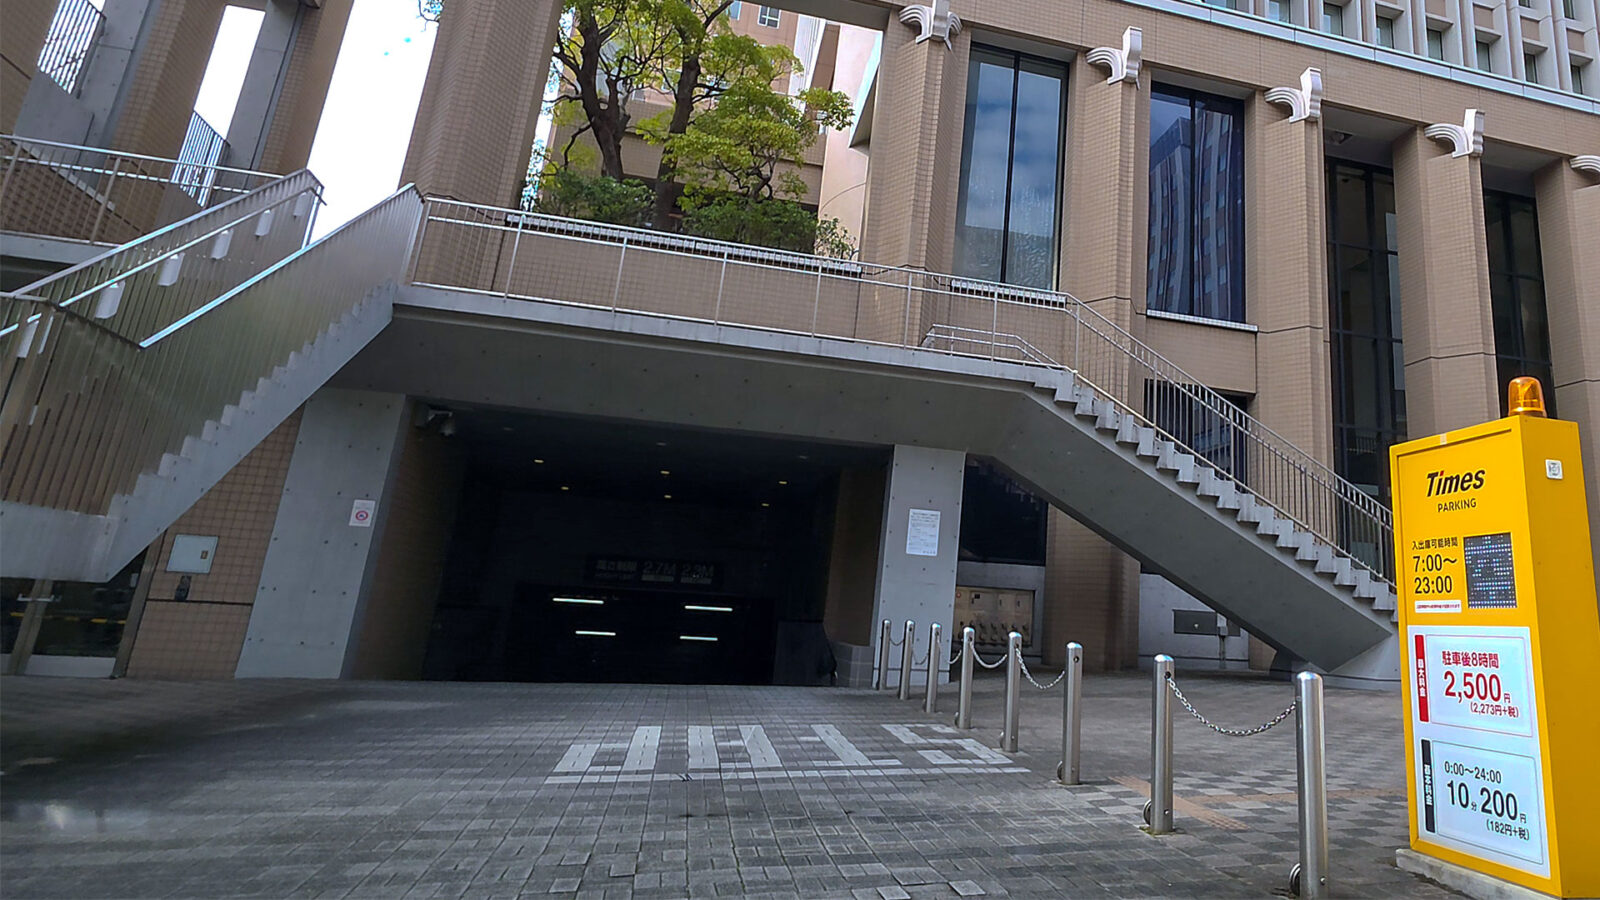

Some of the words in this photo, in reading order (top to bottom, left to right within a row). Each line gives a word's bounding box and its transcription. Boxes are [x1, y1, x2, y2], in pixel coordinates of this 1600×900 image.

[1425, 469, 1486, 497] Times
[1437, 498, 1477, 513] PARKING
[1414, 575, 1453, 594] 23:00
[1441, 650, 1500, 669] 駐車後8時間
